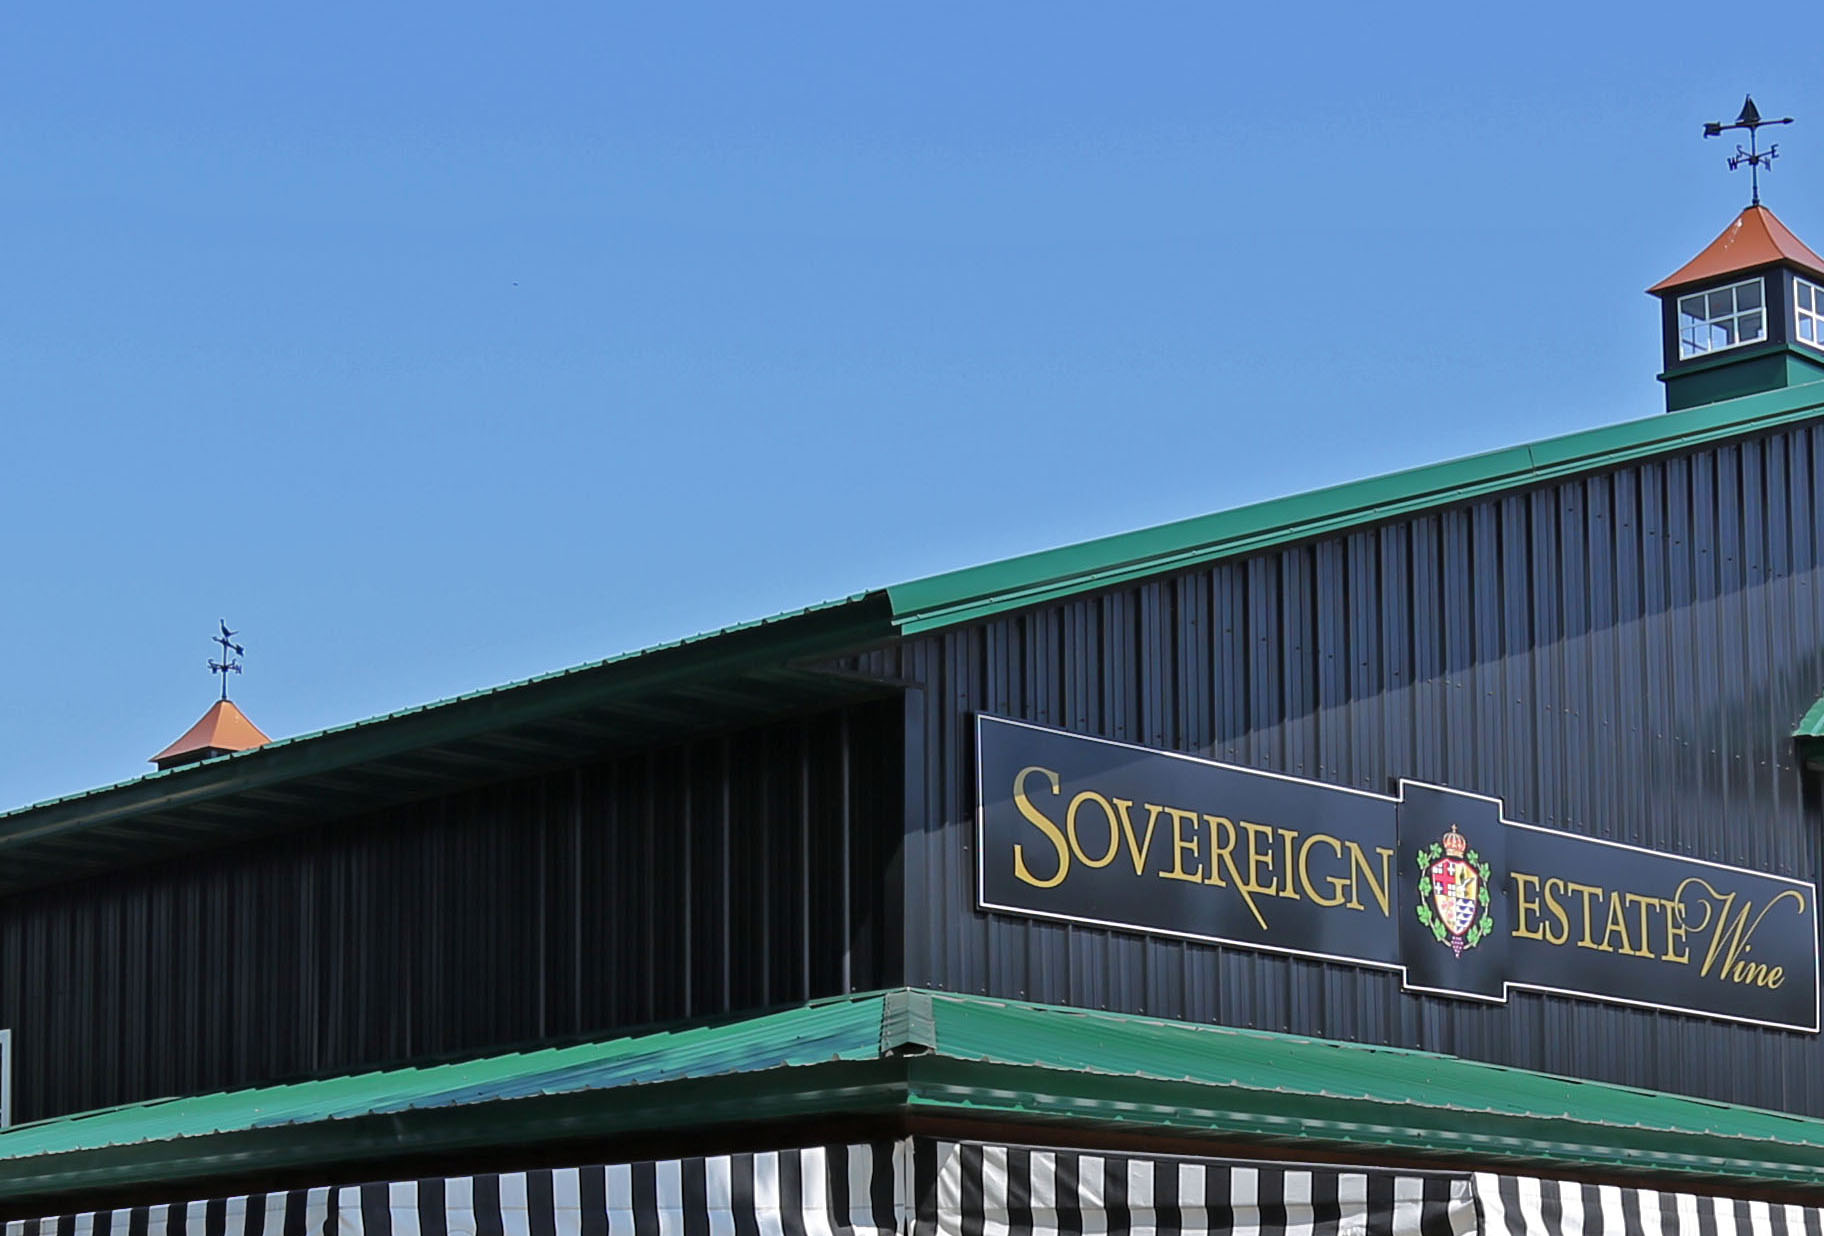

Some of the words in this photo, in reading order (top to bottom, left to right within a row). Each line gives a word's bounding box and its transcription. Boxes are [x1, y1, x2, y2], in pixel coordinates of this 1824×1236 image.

[1013, 766, 1394, 931] SOVEREIGN
[1510, 871, 1690, 965] ESTATE
[1676, 877, 1806, 989] Wine
